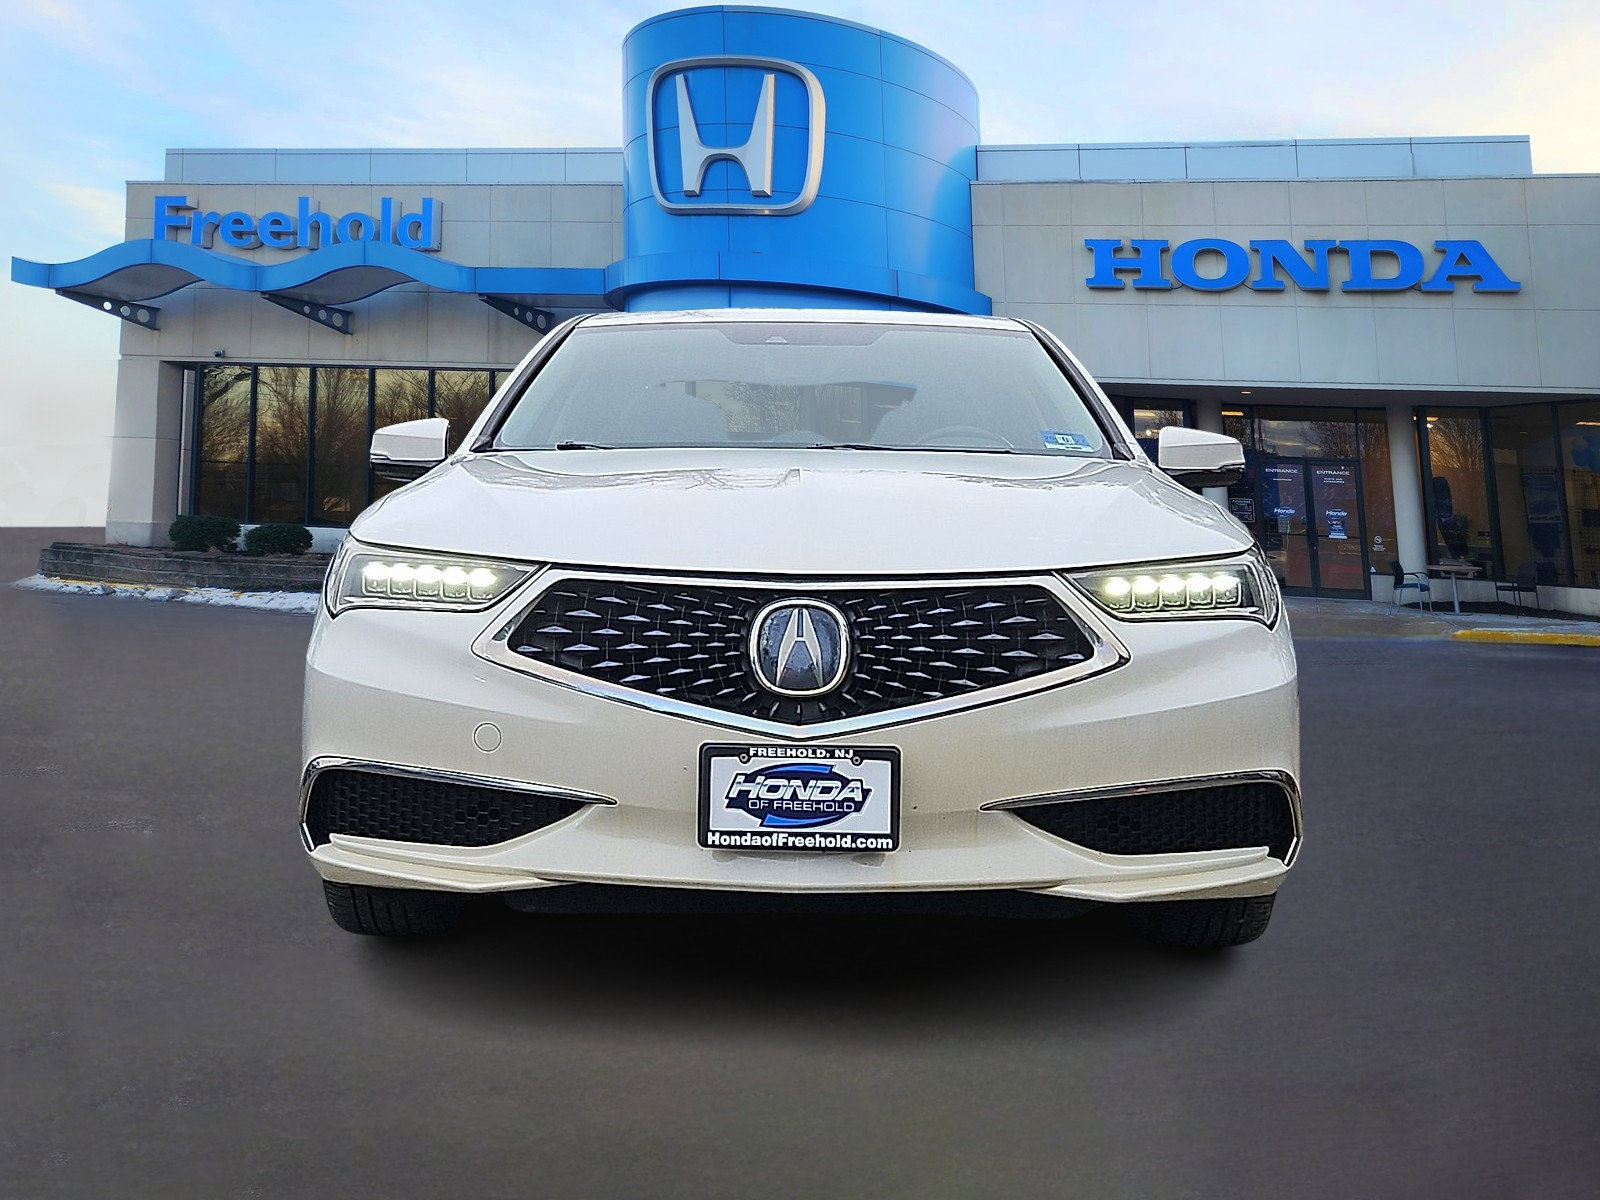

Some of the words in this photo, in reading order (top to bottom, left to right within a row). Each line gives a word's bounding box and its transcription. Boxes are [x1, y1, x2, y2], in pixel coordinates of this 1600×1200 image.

[154, 196, 433, 248] Freehold
[1084, 238, 1521, 293] HONDA
[749, 747, 831, 758] FREEHOLD,
[834, 749, 854, 759] NJ
[727, 775, 863, 801] HONDA
[748, 800, 768, 809] OF
[773, 800, 855, 812] FREEHOLD
[707, 832, 893, 849] HondaofFreehold.com
